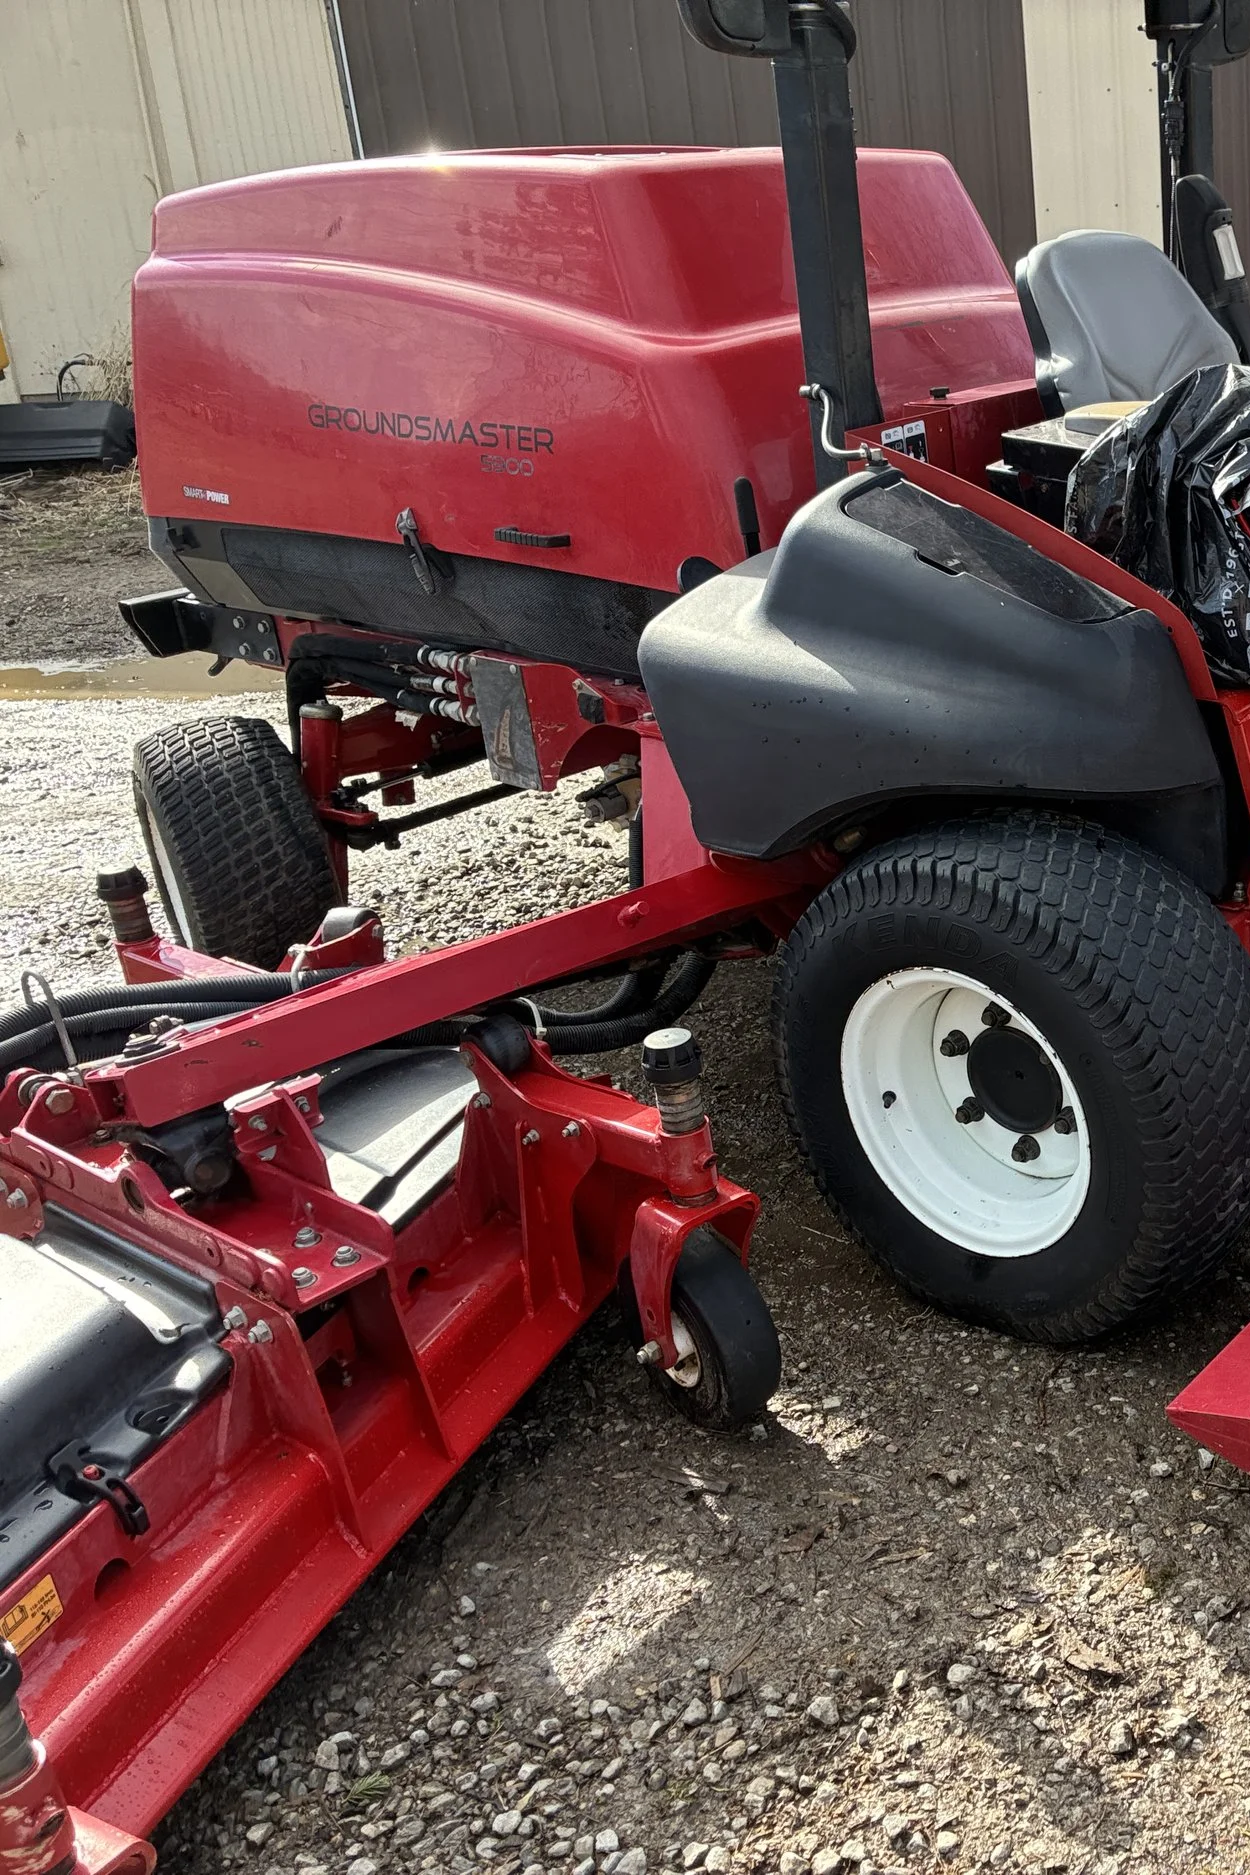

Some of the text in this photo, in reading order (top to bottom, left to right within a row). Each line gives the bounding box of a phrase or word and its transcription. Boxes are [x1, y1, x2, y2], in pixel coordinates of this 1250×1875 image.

[307, 403, 554, 455] GROUNDSMASTER
[206, 490, 230, 505] POWER
[1225, 547, 1240, 579] 196
[1221, 588, 1238, 638] EST'D
[831, 912, 1020, 989] KENDA
